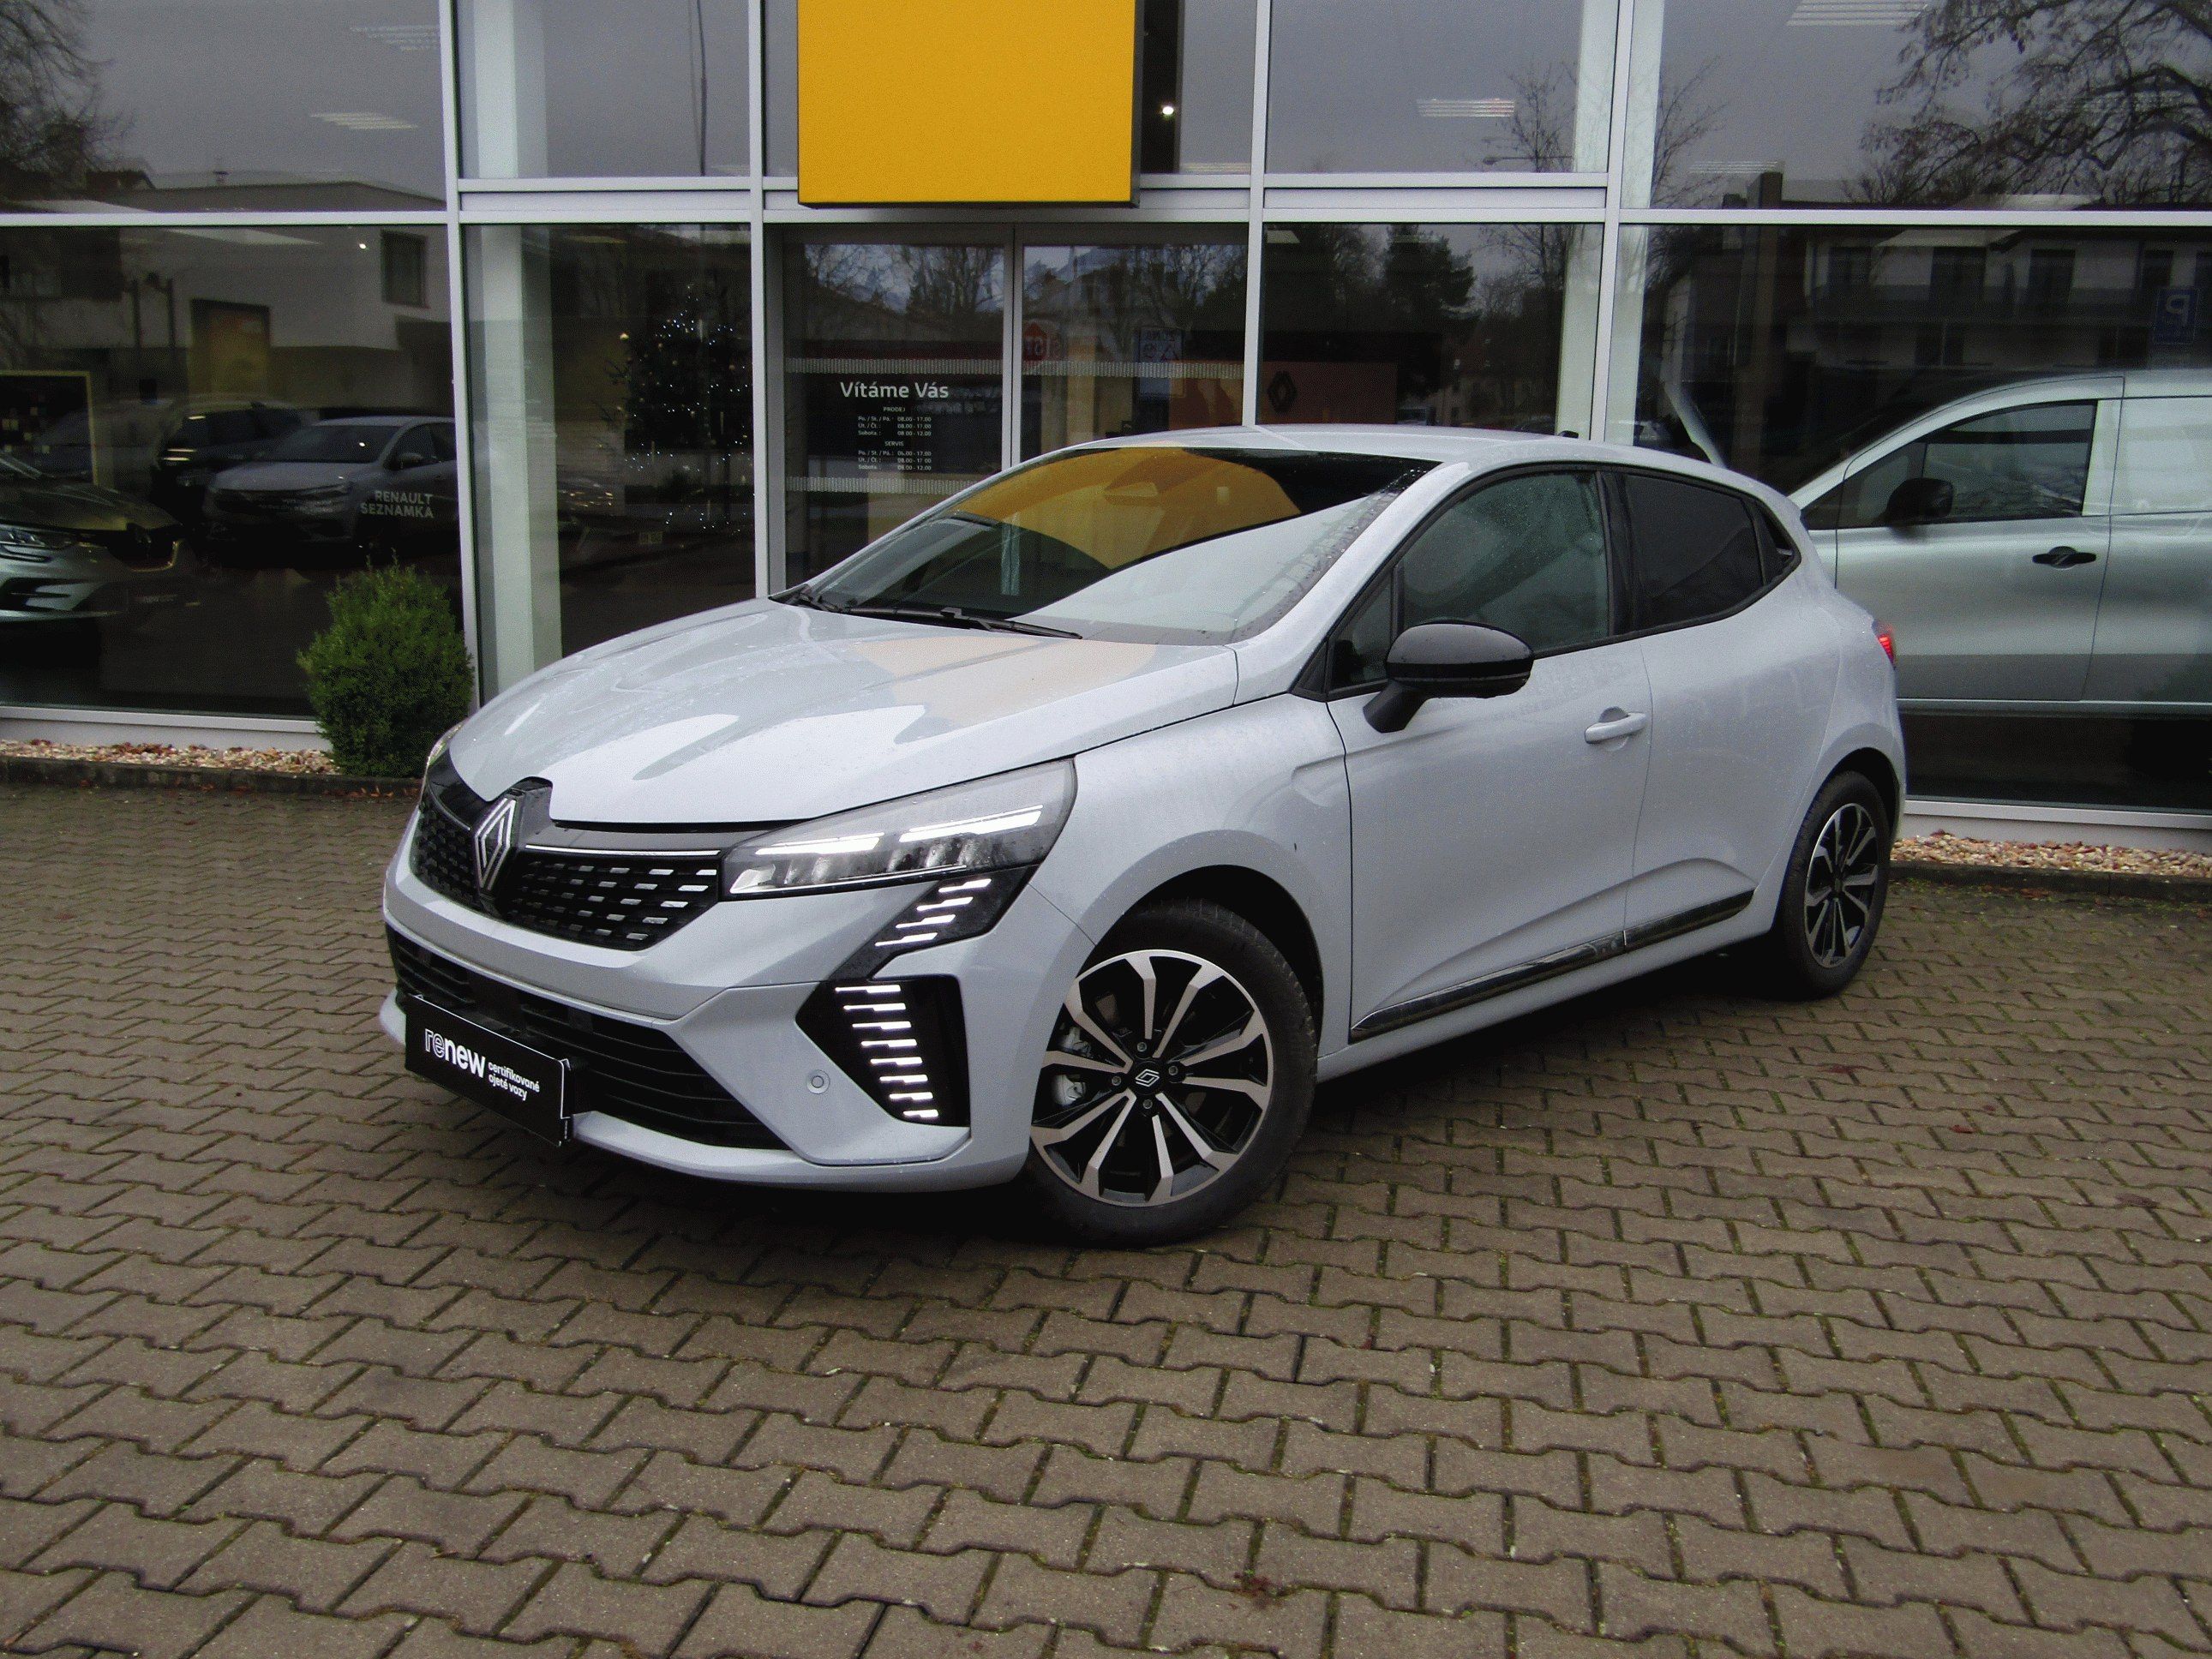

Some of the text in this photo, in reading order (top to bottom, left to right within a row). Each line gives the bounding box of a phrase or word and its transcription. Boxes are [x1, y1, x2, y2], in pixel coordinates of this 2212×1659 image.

[840, 380, 950, 398] Vítáme Vás
[375, 490, 434, 505] RENAULT
[360, 503, 435, 518] SEZNAMKA
[424, 1028, 486, 1078] renew
[488, 1061, 540, 1093] certifikované
[488, 1074, 528, 1101] ojeté vozy
